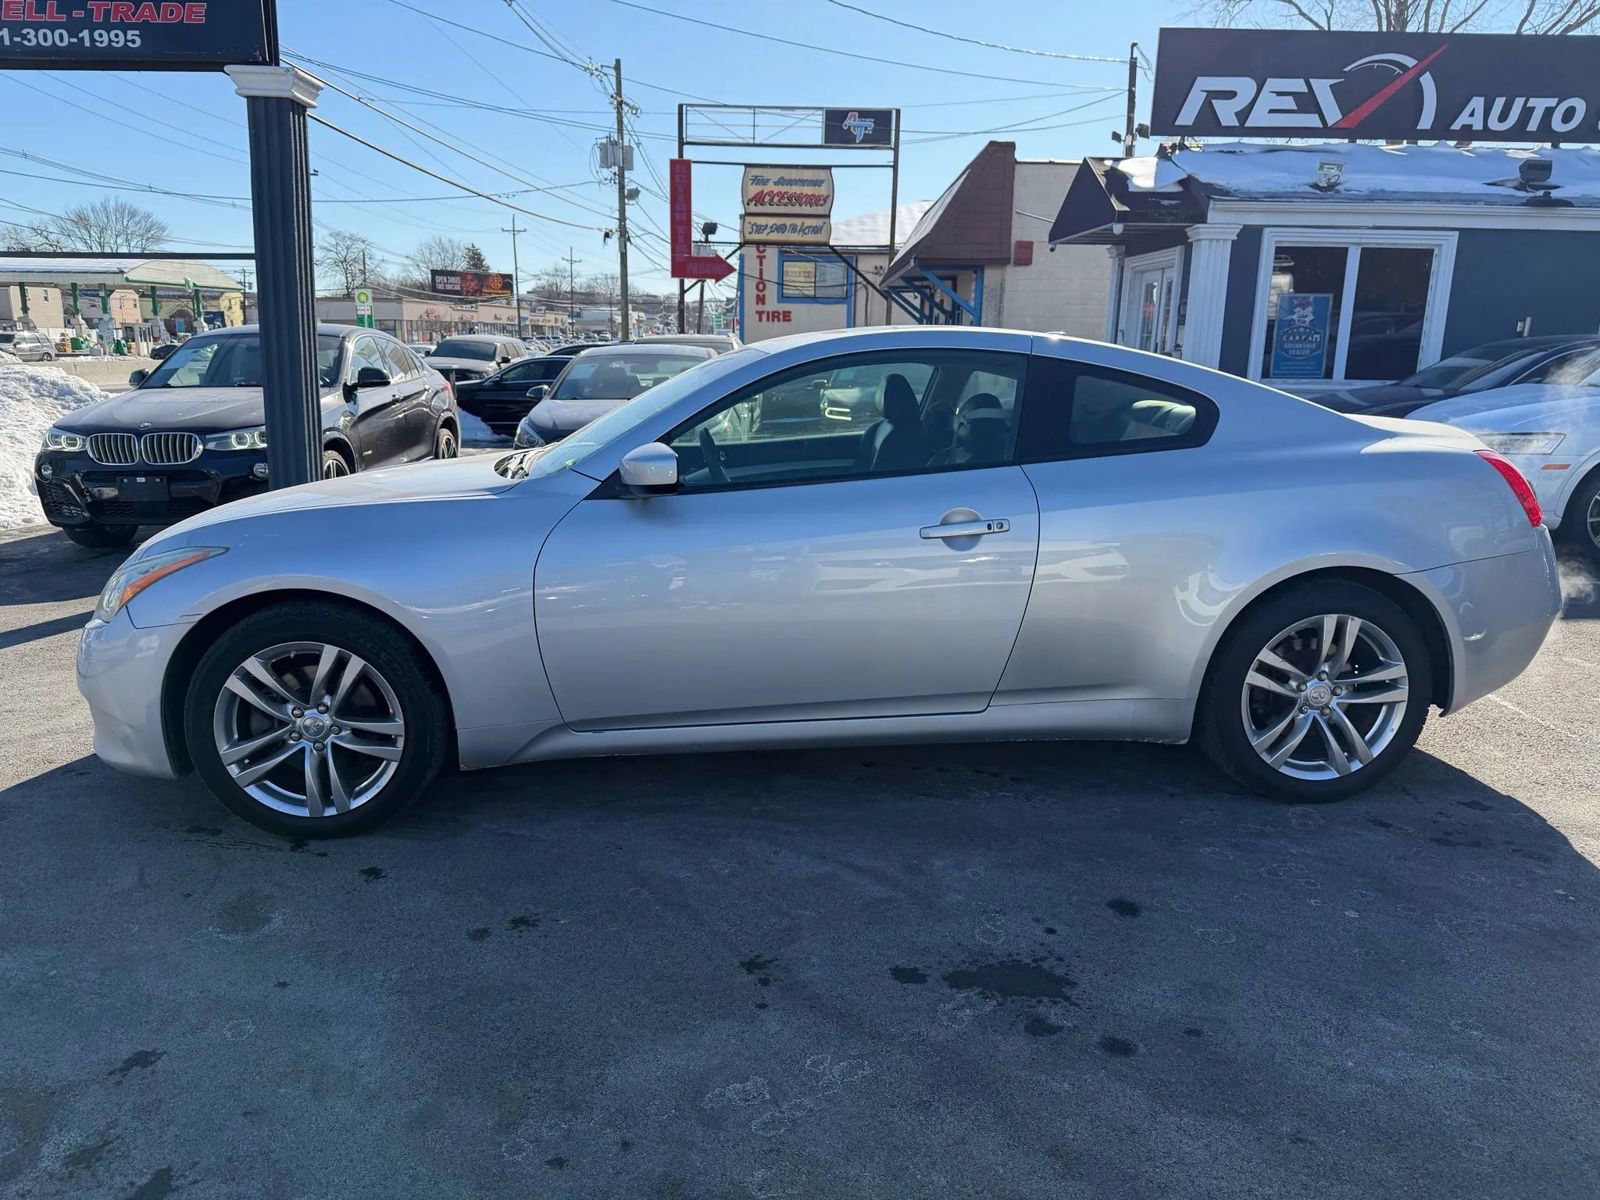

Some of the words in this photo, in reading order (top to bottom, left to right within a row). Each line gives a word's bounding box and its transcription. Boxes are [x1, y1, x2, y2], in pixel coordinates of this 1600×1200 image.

[1449, 96, 1587, 132] AUTO
[755, 245, 767, 306] CTION
[755, 310, 792, 322] TIRE
